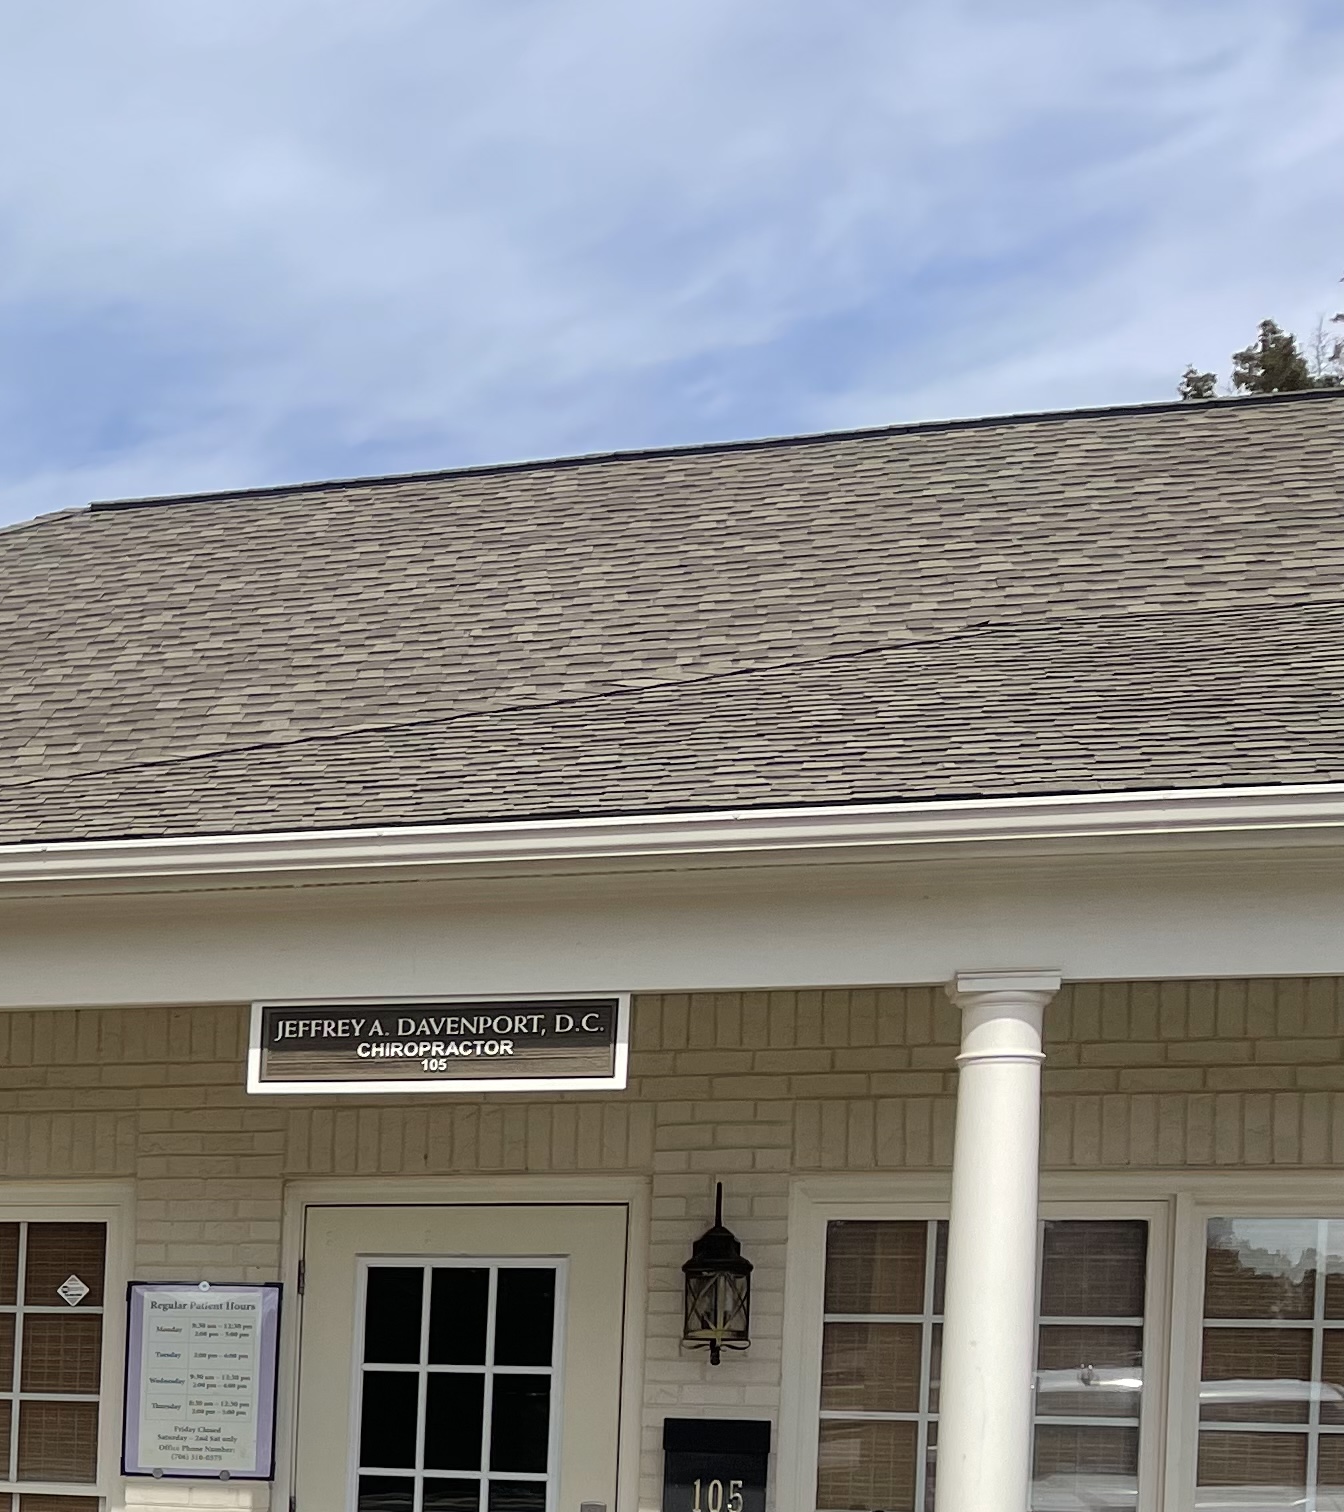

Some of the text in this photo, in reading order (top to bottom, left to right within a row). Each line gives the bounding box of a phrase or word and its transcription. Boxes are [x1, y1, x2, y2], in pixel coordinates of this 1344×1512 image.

[273, 1013, 606, 1042] JEFFREY A. DAVENPORT, D.C.
[356, 1040, 514, 1058] CHIROPRACTOR
[420, 1058, 448, 1072] 105
[150, 1301, 256, 1312] Regular Patient Hours
[155, 1351, 182, 1359] Tuesday
[148, 1377, 185, 1386] Wednesday
[151, 1402, 182, 1410] Thursday
[174, 1425, 196, 1433] Friday
[157, 1434, 188, 1442] Saturday
